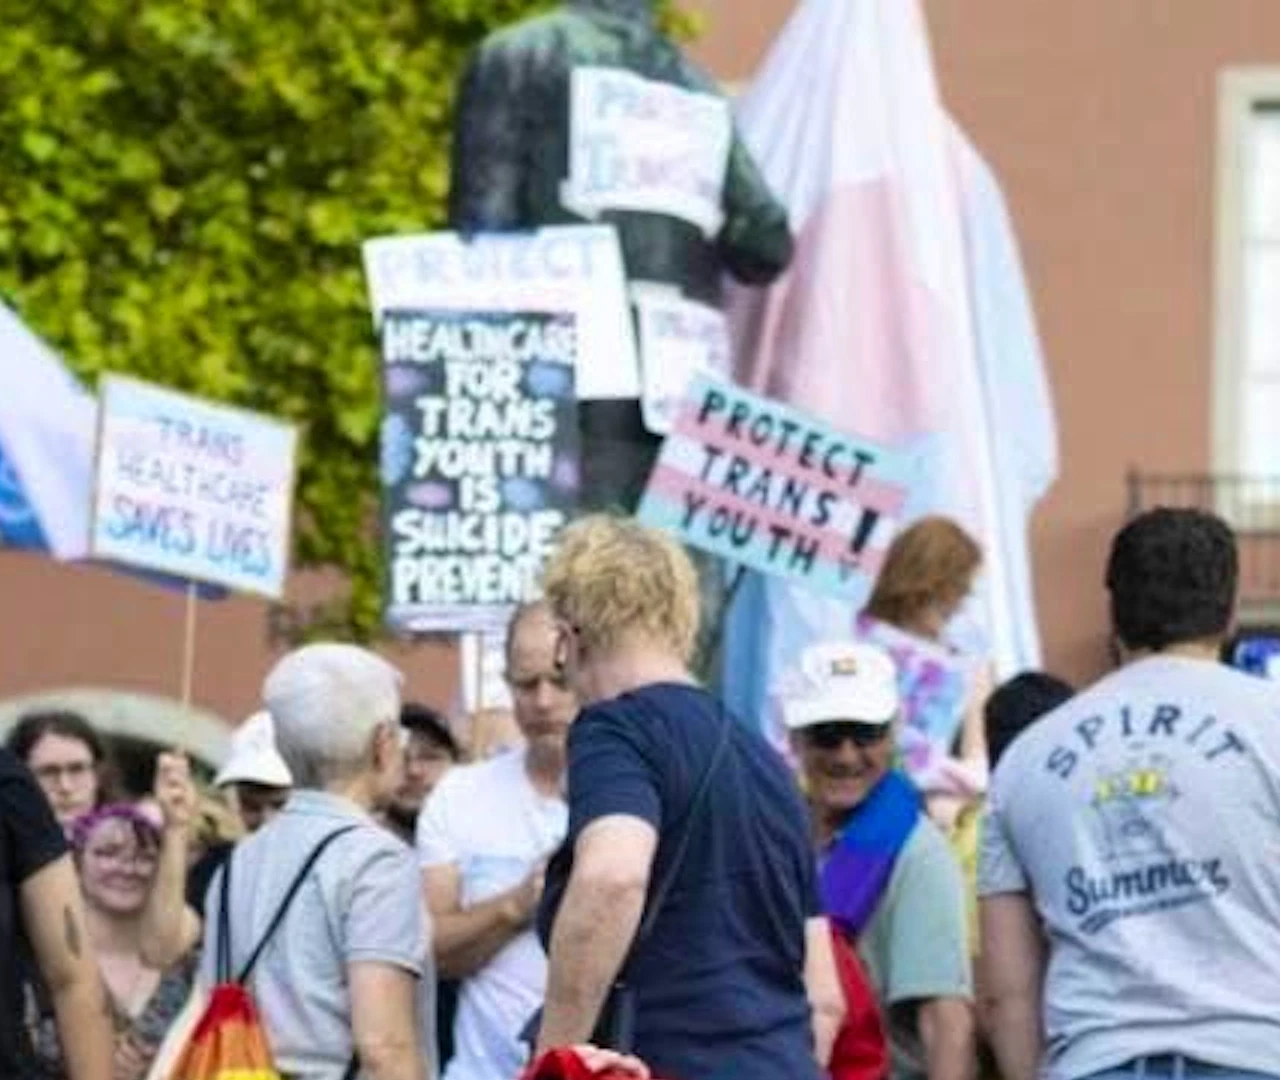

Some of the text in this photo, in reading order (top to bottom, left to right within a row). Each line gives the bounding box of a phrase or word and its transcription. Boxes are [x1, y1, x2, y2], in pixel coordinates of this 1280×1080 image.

[384, 319, 575, 365] HEALTHCARE
[445, 360, 523, 400] FOR
[415, 397, 557, 439] TRANS
[697, 389, 875, 486] PROTECT
[414, 437, 553, 478] YOUTH
[458, 475, 501, 512] IS
[700, 445, 839, 526] TRANS
[107, 492, 272, 578] SAVES LIVES
[392, 509, 564, 556] SUICIDE
[681, 492, 821, 574] YOUTH
[1047, 705, 1247, 779] SPIRIT
[1065, 858, 1231, 915] Summer
